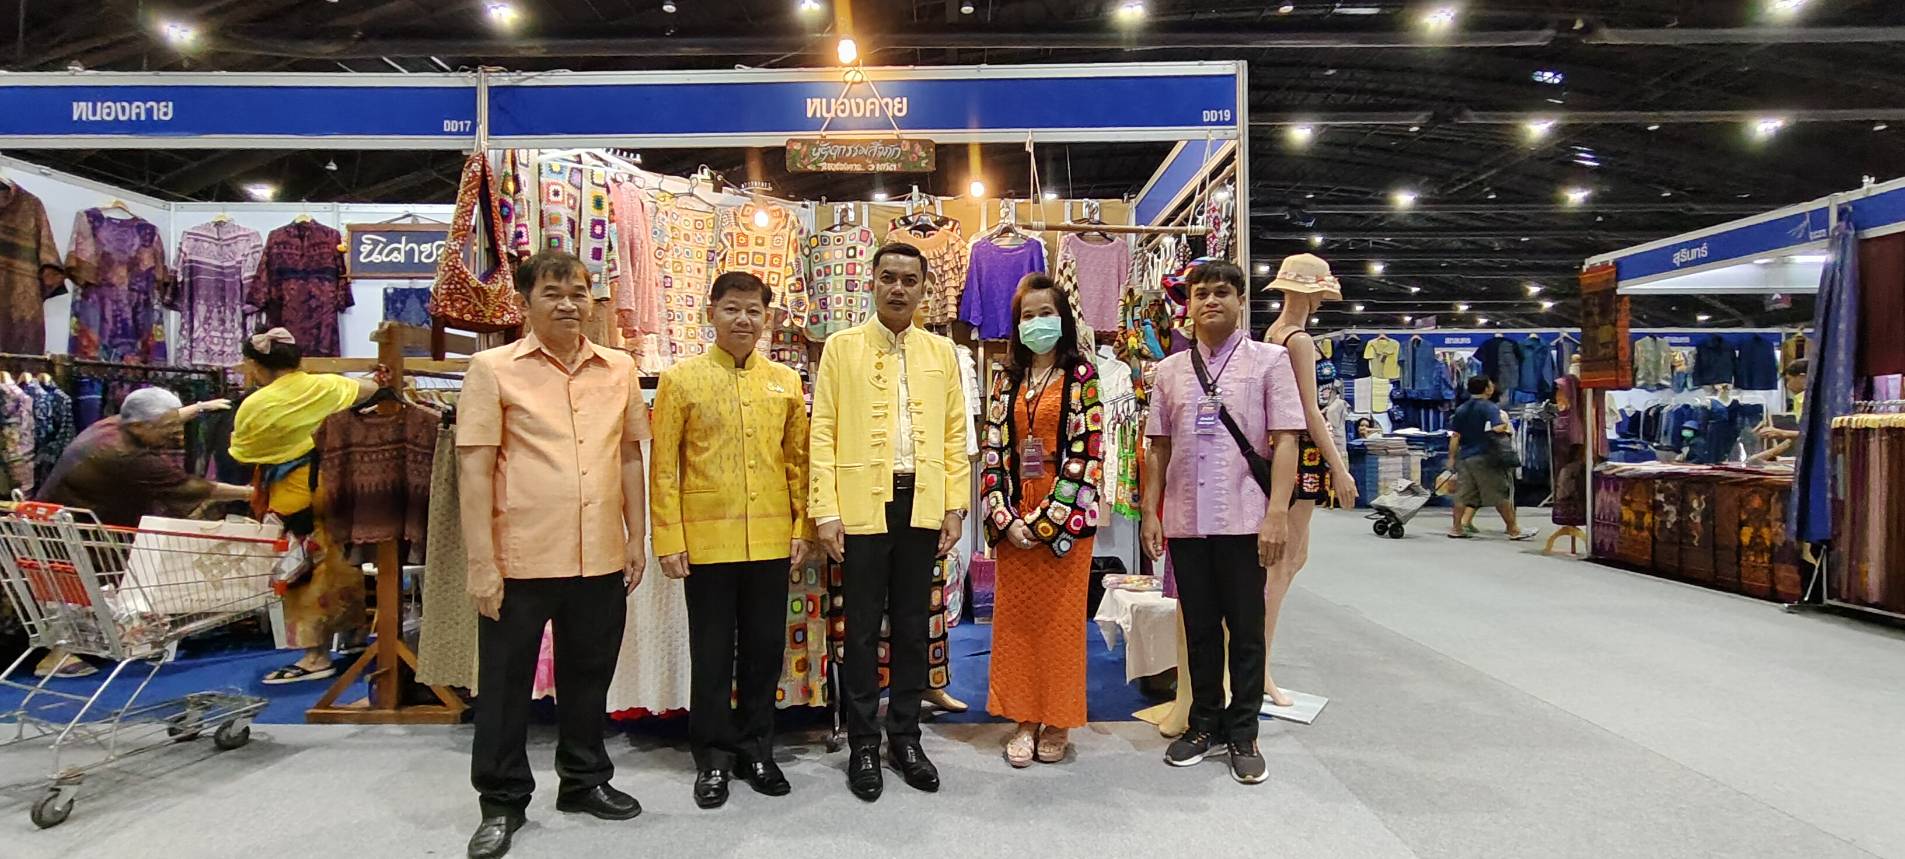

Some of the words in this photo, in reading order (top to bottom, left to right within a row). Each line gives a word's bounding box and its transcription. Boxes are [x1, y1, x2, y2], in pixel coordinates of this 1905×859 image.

[72, 101, 173, 121] หนองคาย
[806, 97, 908, 118] หนองคาย
[1203, 109, 1231, 122] DD19
[443, 120, 472, 132] DD17
[1672, 242, 1708, 267] สุรินทร์
